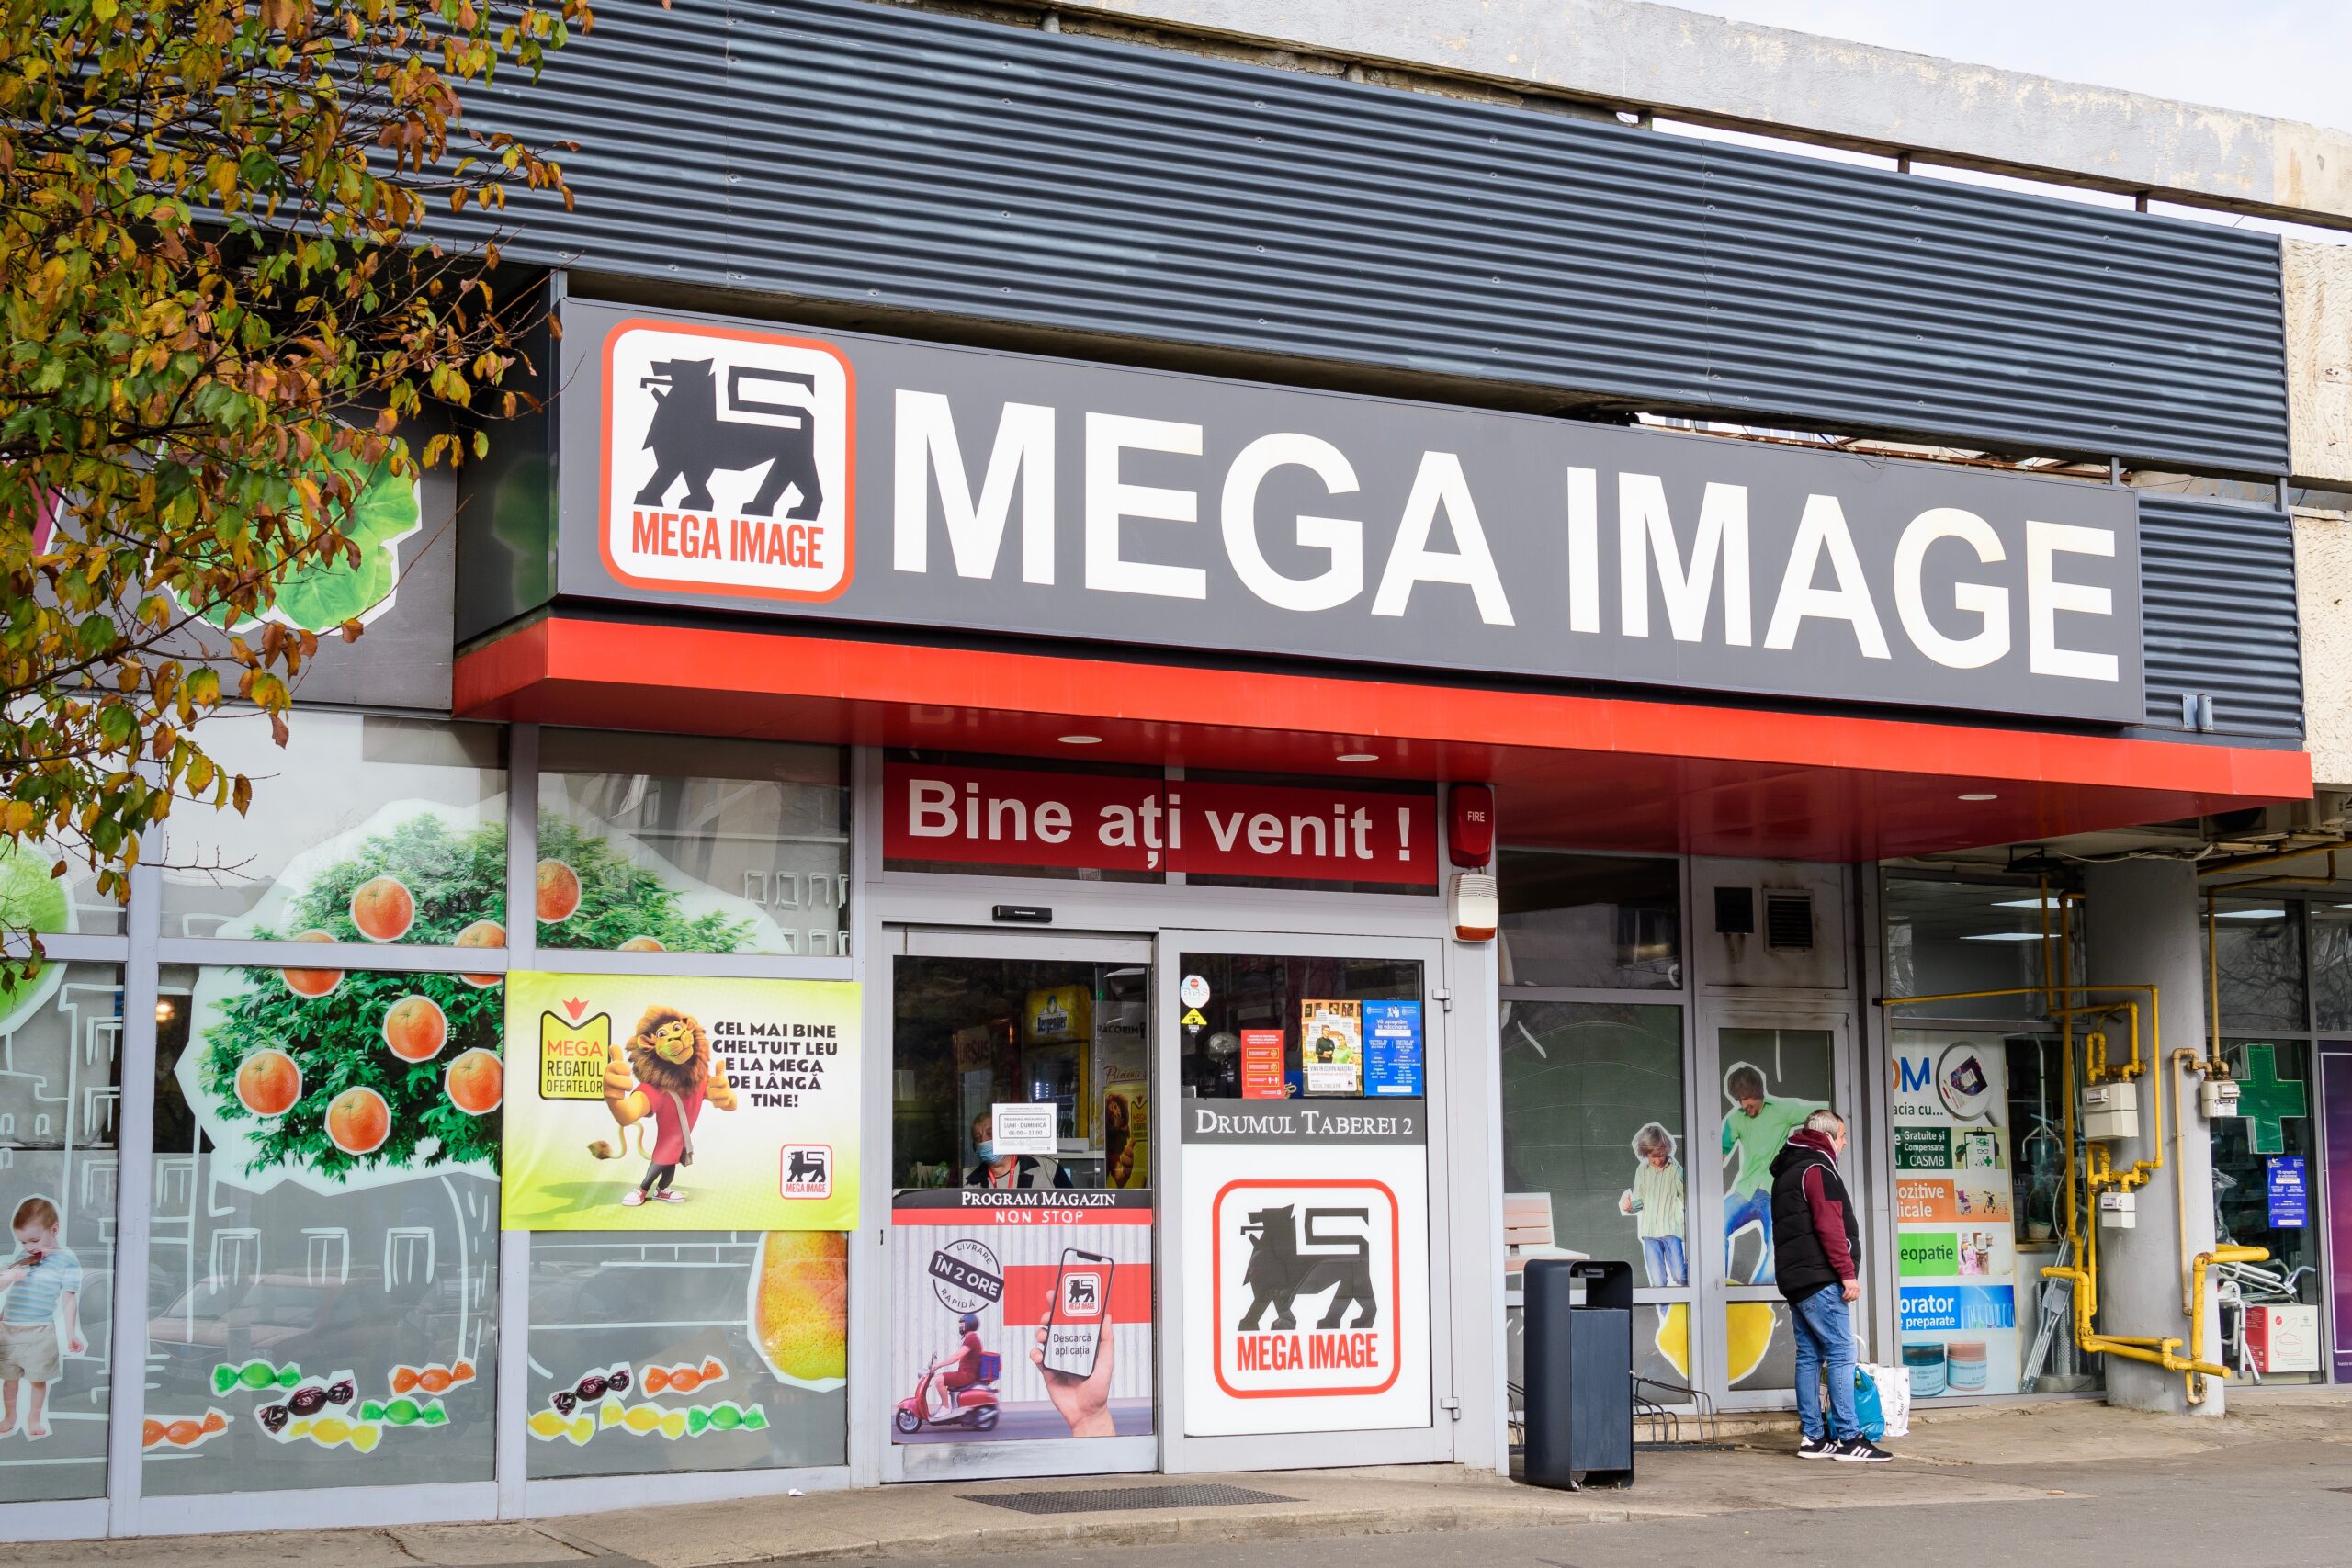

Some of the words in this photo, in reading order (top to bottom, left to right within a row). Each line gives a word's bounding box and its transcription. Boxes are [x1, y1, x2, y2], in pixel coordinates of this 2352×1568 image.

[632, 511, 721, 560] MEGA
[730, 519, 824, 570] IMAGE
[893, 389, 1516, 626] MEGA
[1566, 467, 2120, 682] IMAGE
[908, 778, 1072, 843] Bine
[1098, 794, 1181, 869] ați
[1204, 804, 1373, 860] venit
[1396, 807, 1411, 861] !
[1467, 811, 1485, 822] FIRE
[714, 1021, 745, 1035] CEL
[750, 1022, 787, 1037] MAI
[793, 1024, 836, 1038] BINE
[547, 1040, 603, 1057] MEGA
[712, 1040, 800, 1055] CHELTUIT
[806, 1042, 837, 1055] LEU
[959, 1039, 989, 1064] URSUS
[547, 1060, 603, 1077] REGATUL
[726, 1058, 735, 1070] E
[740, 1058, 764, 1071] LA
[770, 1059, 824, 1073] MEGA
[547, 1080, 603, 1093] OFERTELOR
[728, 1075, 750, 1089] DE
[755, 1072, 822, 1090] LÂNGĂ
[751, 1094, 798, 1107] TINE!
[1918, 1105, 1943, 1115] cu...
[1195, 1110, 1296, 1134] DRUMUL
[1301, 1111, 1396, 1134] TABEREI
[1403, 1118, 1413, 1134] 2
[1904, 1131, 1936, 1140] Gratuite
[1904, 1143, 1945, 1153] Compensate
[1909, 1155, 1945, 1167] CASMB
[786, 1183, 805, 1192] MEGA
[807, 1183, 826, 1192] IMAGE
[1896, 1183, 1944, 1198] ozitive
[961, 1191, 1038, 1206] PROGRAM
[1041, 1191, 1115, 1206] MAGAZIN
[995, 1211, 1032, 1223] NON
[1041, 1211, 1083, 1223] STOP
[956, 1242, 993, 1265] LIVRARE
[1900, 1245, 1953, 1263] eopatie
[934, 1254, 953, 1275] ÎN
[954, 1267, 965, 1281] 2
[967, 1272, 1001, 1297] ORE
[940, 1288, 976, 1309] RAPIDĂ
[1900, 1295, 1954, 1313] orator
[1906, 1315, 1955, 1329] preparate
[1053, 1333, 1091, 1342] Descarcă
[1055, 1346, 1090, 1358] aplicația
[1237, 1334, 1303, 1371] MEGA
[1309, 1333, 1378, 1369] IMAGE
